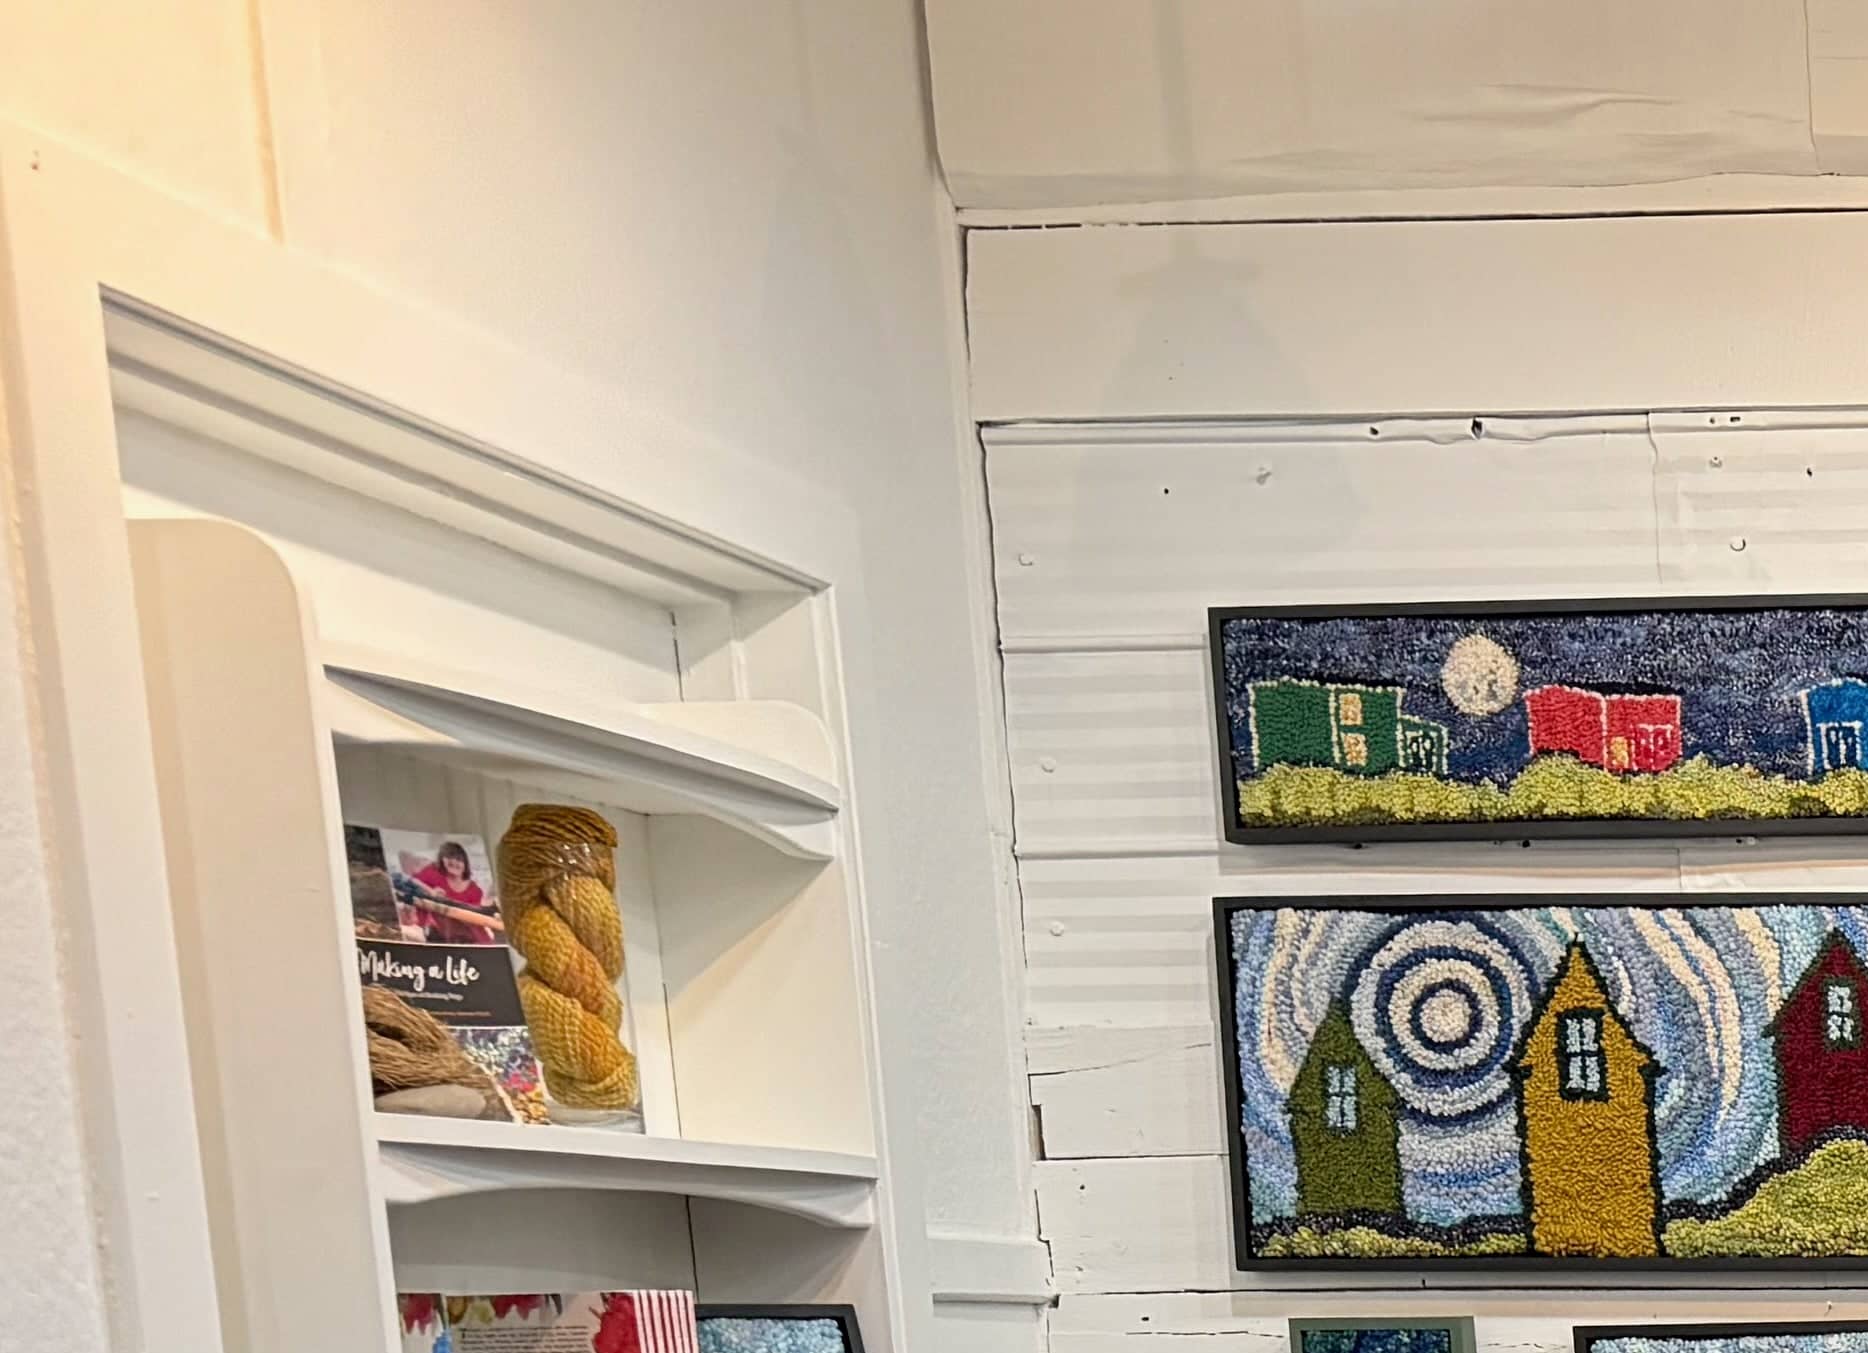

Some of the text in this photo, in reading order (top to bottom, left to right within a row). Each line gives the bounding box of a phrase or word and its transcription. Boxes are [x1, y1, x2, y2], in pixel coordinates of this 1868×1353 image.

[357, 947, 480, 991] Making a Life
